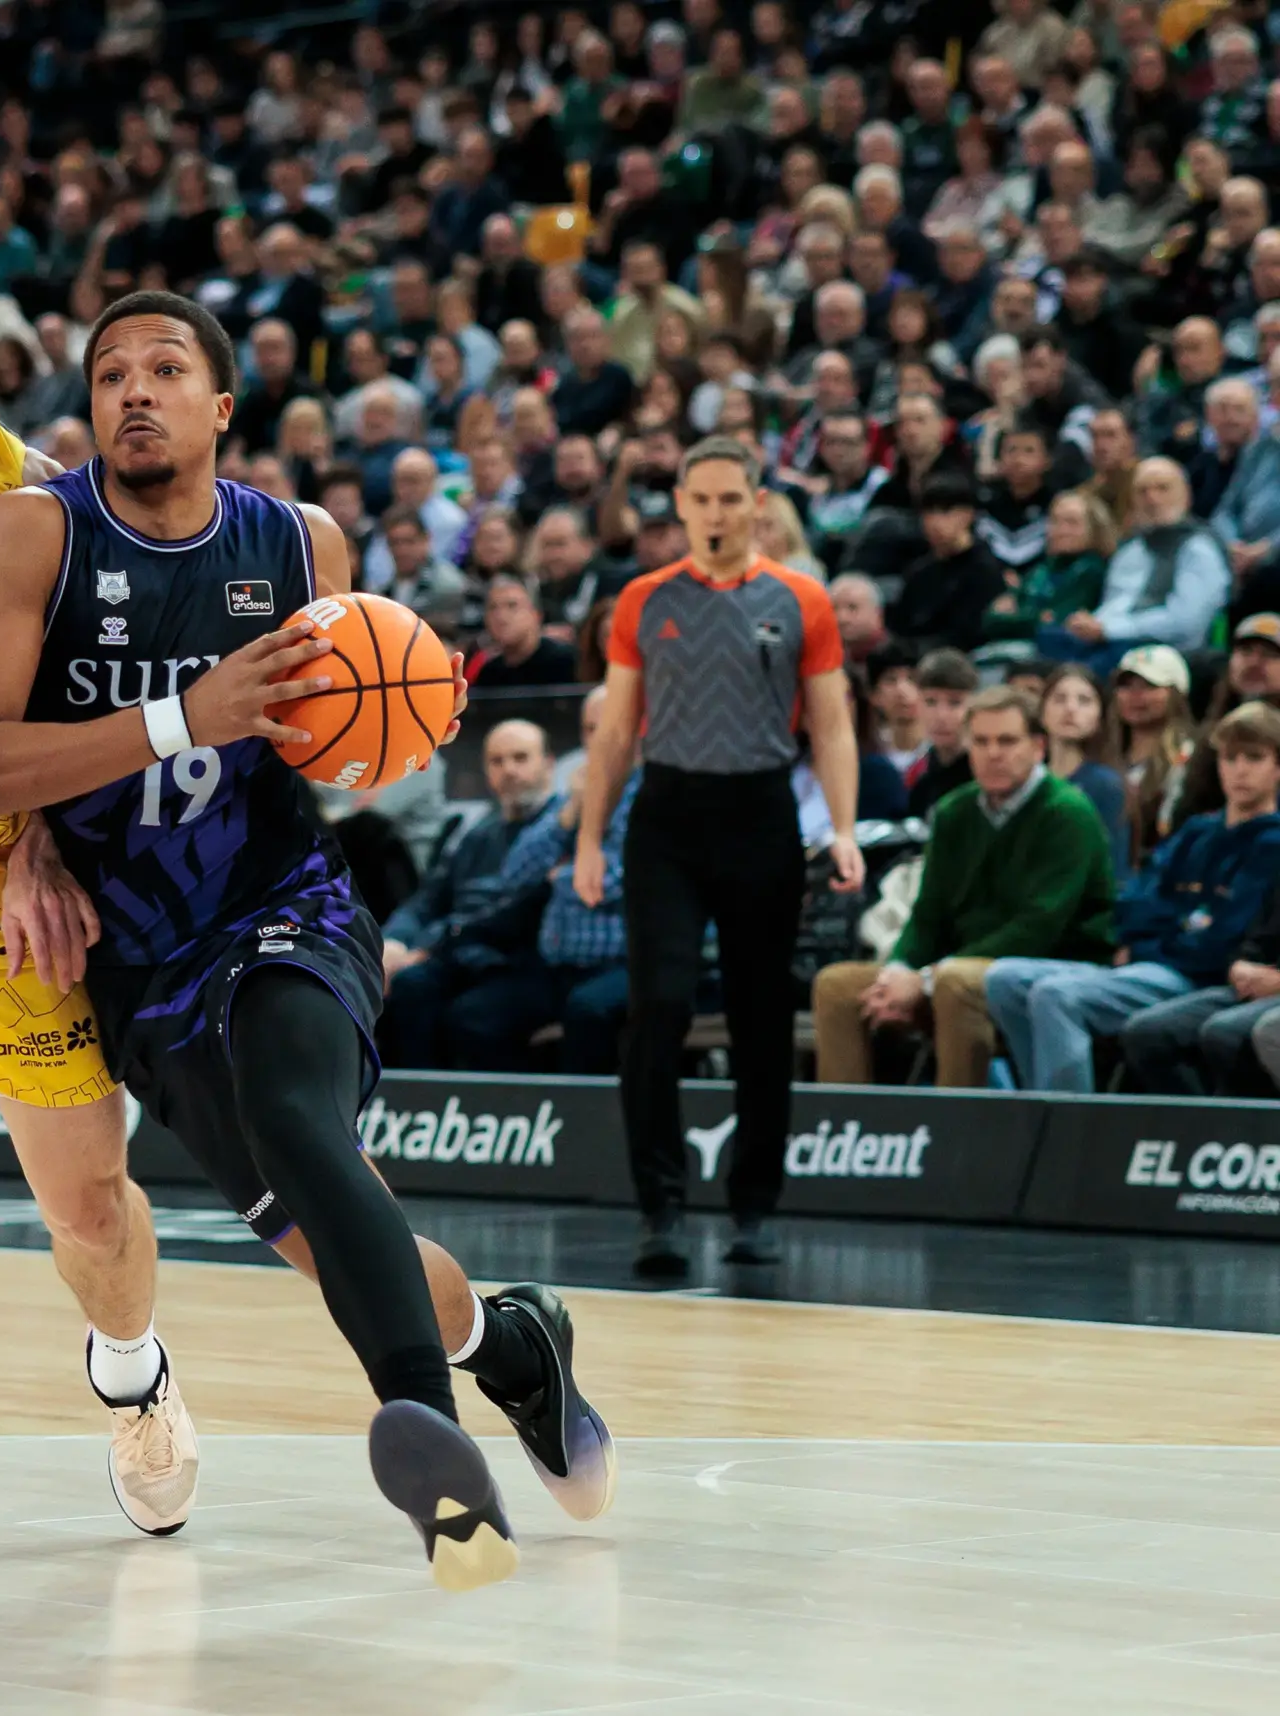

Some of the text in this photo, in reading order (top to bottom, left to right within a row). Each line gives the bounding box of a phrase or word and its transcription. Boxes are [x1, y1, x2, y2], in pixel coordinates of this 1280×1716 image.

[232, 592, 251, 603] liga
[233, 601, 271, 611] endesa
[139, 746, 222, 826] 19
[263, 924, 291, 934] acb
[17, 1030, 61, 1046] Islas
[357, 1096, 563, 1166] txabank
[1125, 1140, 1183, 1187] EL
[246, 1190, 276, 1219] CORRE
